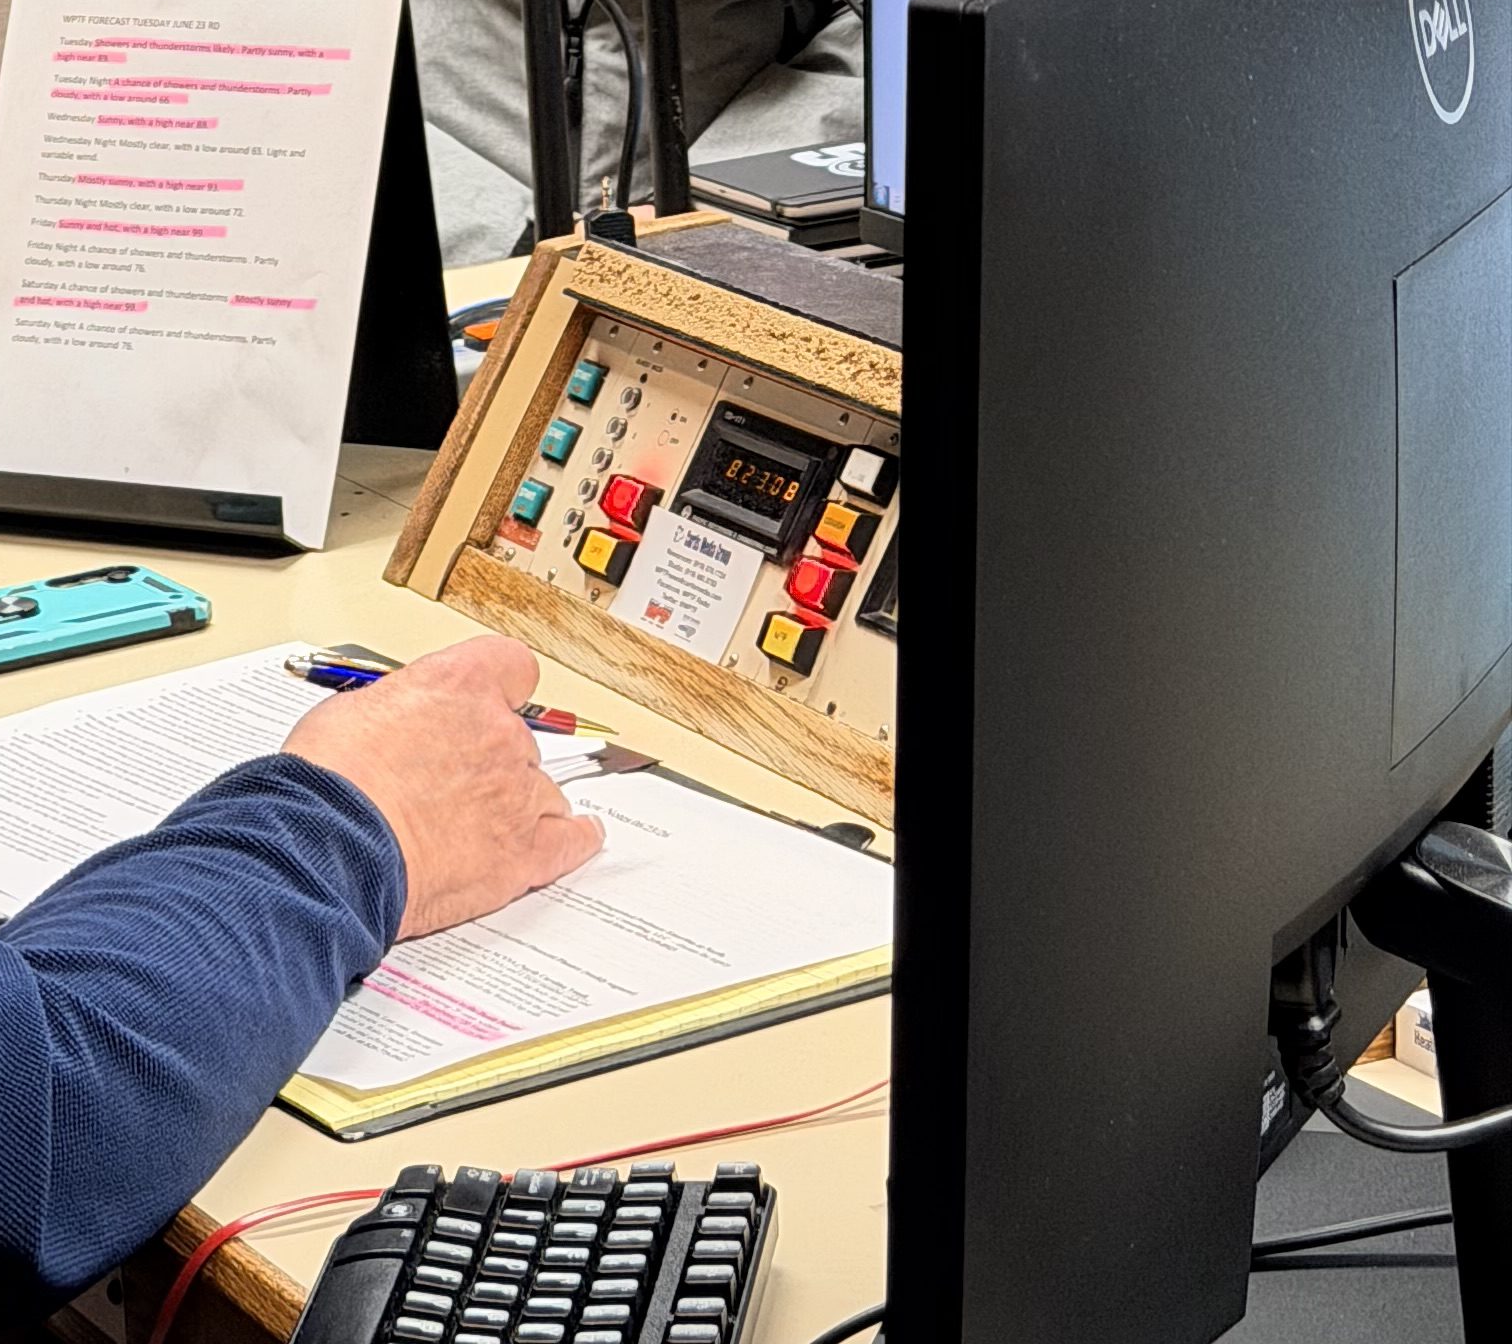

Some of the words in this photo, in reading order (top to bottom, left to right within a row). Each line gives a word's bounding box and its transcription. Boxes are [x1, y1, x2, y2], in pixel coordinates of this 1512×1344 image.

[88, 16, 133, 26] FORECAST
[133, 17, 170, 28] TUESDAY
[172, 20, 193, 29] JUNE
[94, 38, 130, 49] Showers
[131, 40, 148, 50] and
[149, 41, 211, 53] thunderstorms
